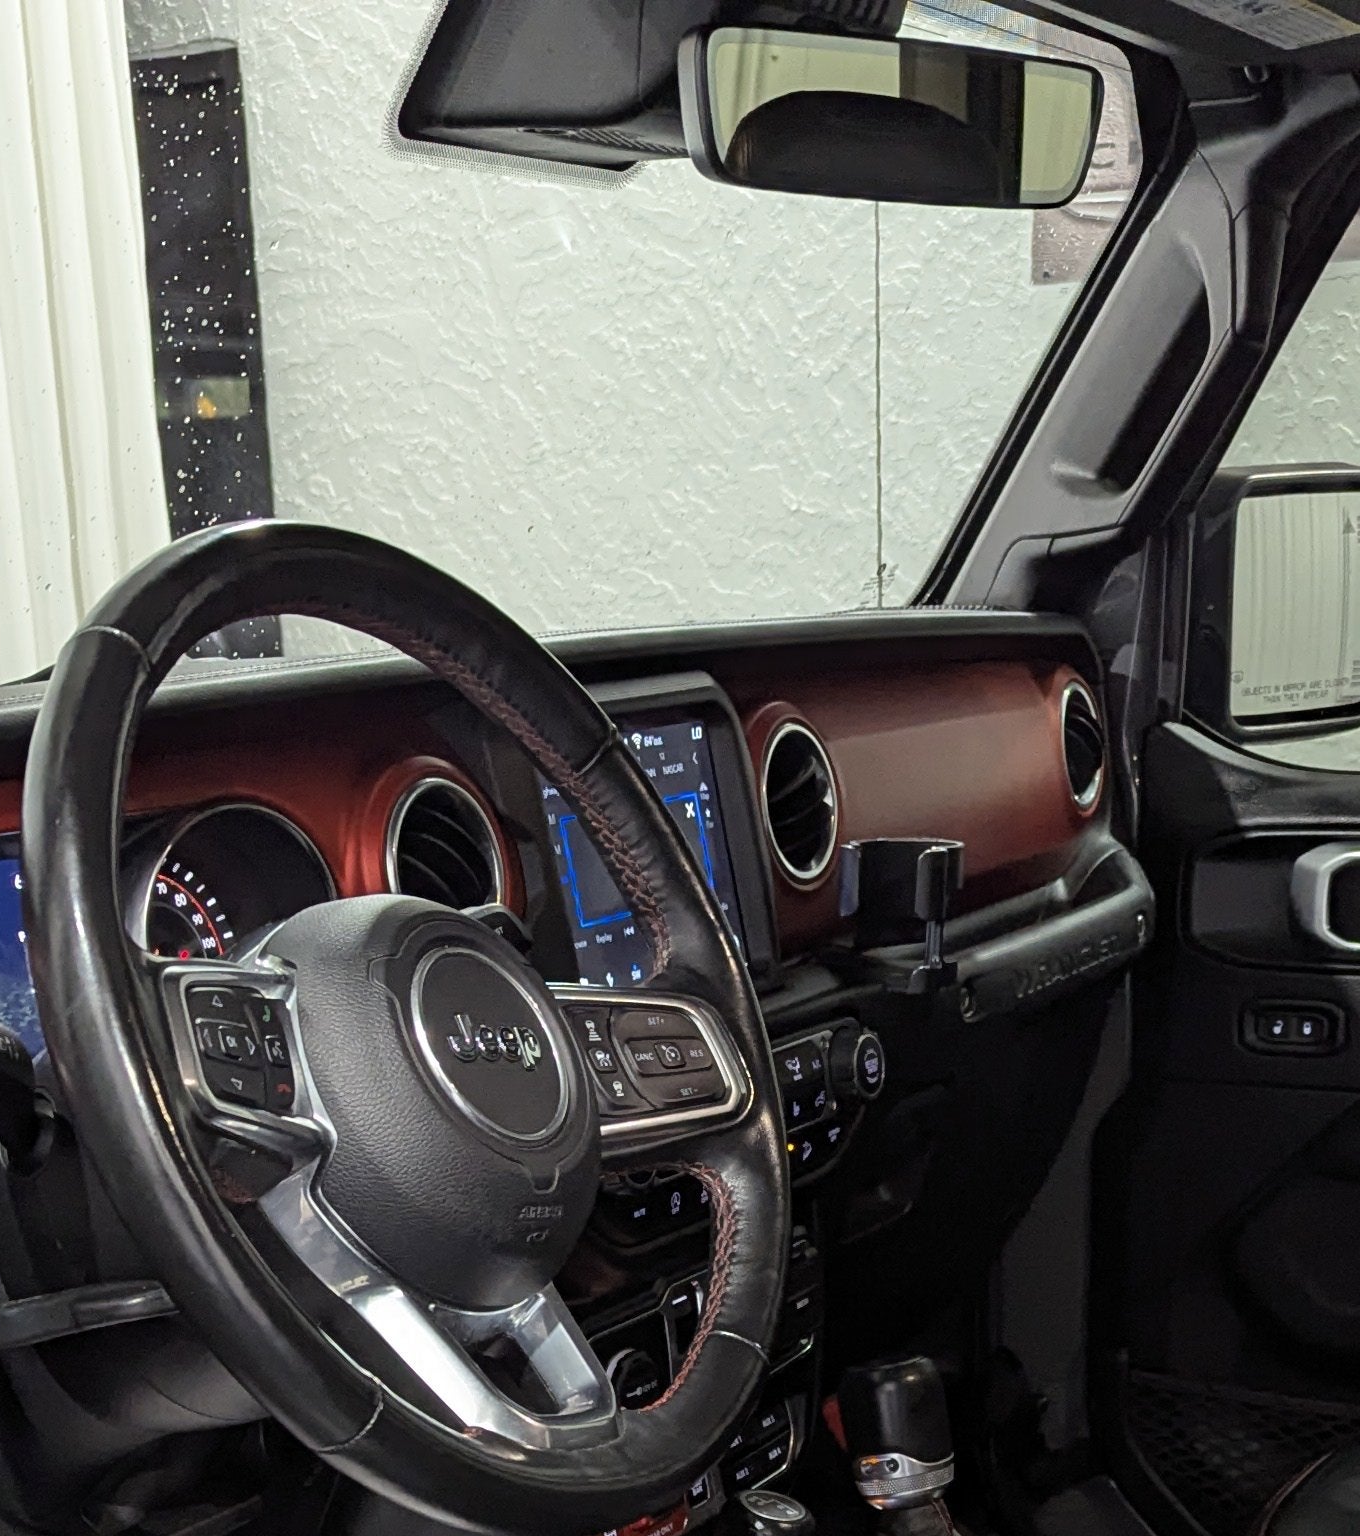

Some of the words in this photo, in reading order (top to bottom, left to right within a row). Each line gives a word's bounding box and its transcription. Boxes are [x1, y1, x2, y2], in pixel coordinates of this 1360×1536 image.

[662, 763, 685, 775] NASCAR
[155, 881, 168, 895] 70
[174, 893, 187, 907] 80
[191, 913, 204, 925] 90
[201, 936, 216, 949] 100
[446, 1013, 542, 1071] Jeep
[634, 1051, 655, 1063] CANC
[690, 1048, 705, 1060] RES
